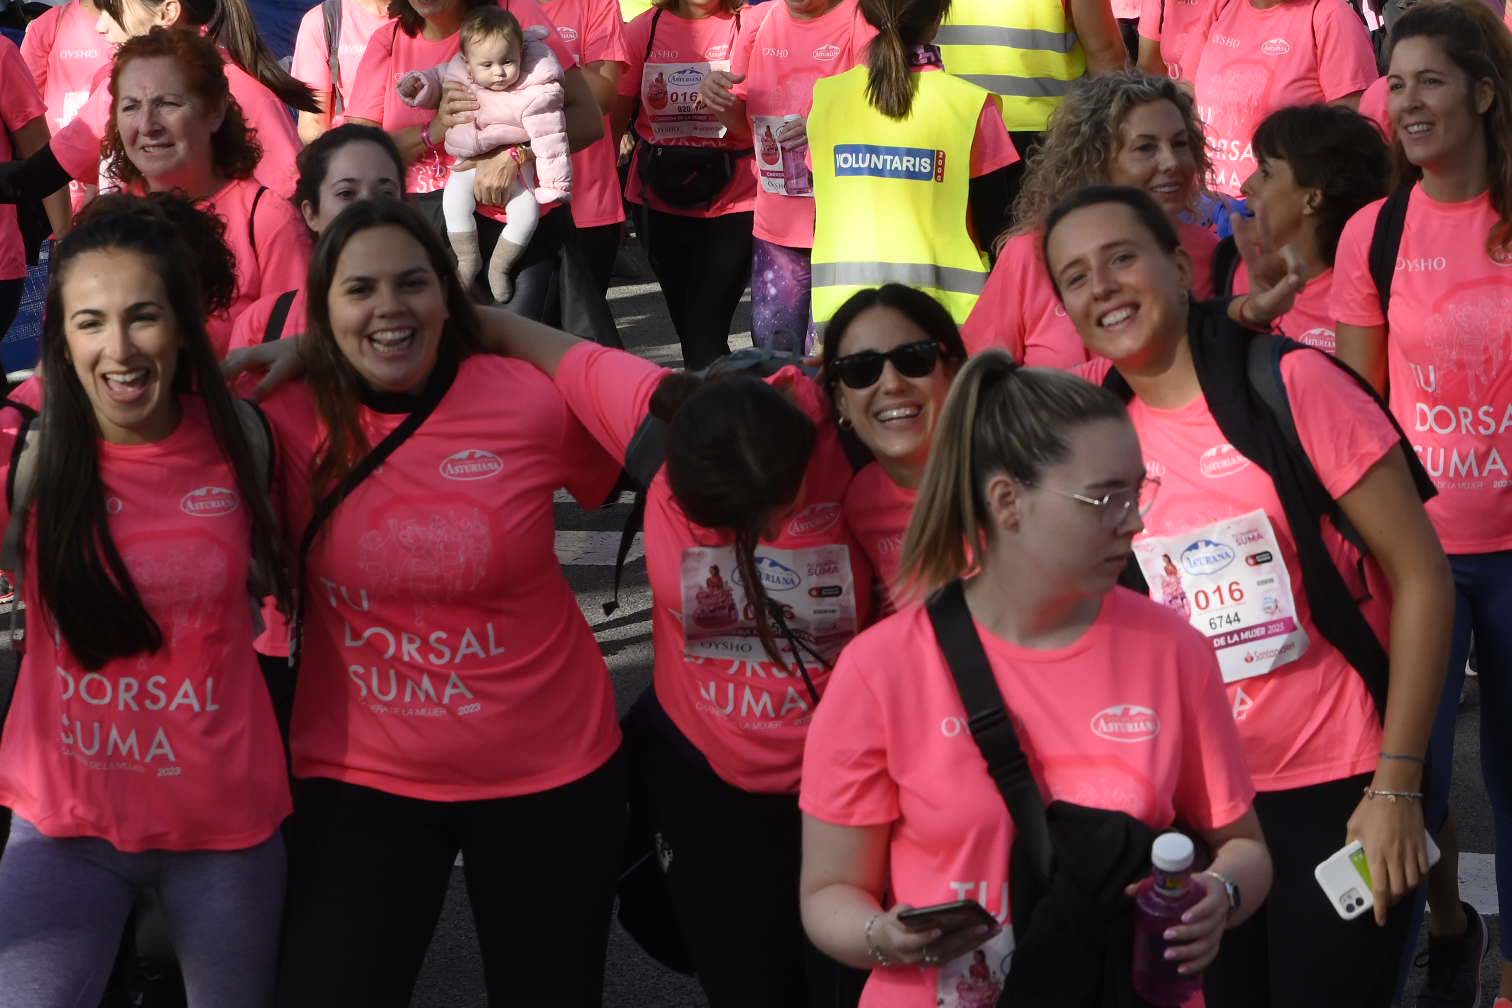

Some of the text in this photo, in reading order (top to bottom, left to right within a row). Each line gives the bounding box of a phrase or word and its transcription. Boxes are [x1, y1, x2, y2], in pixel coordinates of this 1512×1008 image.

[670, 91, 698, 103] 016
[1395, 255, 1447, 272] OYSHO
[444, 462, 500, 476] ASTURIANA
[1235, 531, 1265, 546] SUMA
[807, 564, 840, 577] SUMA
[1194, 580, 1245, 611] 016
[742, 603, 795, 622] 06
[1208, 611, 1242, 631] 6744
[1213, 636, 1226, 648] DE
[1226, 633, 1240, 646] LA
[1240, 627, 1267, 643] MUJER
[700, 642, 753, 653] OYSHO
[347, 664, 474, 705] SUMA
[457, 702, 482, 716] 2023
